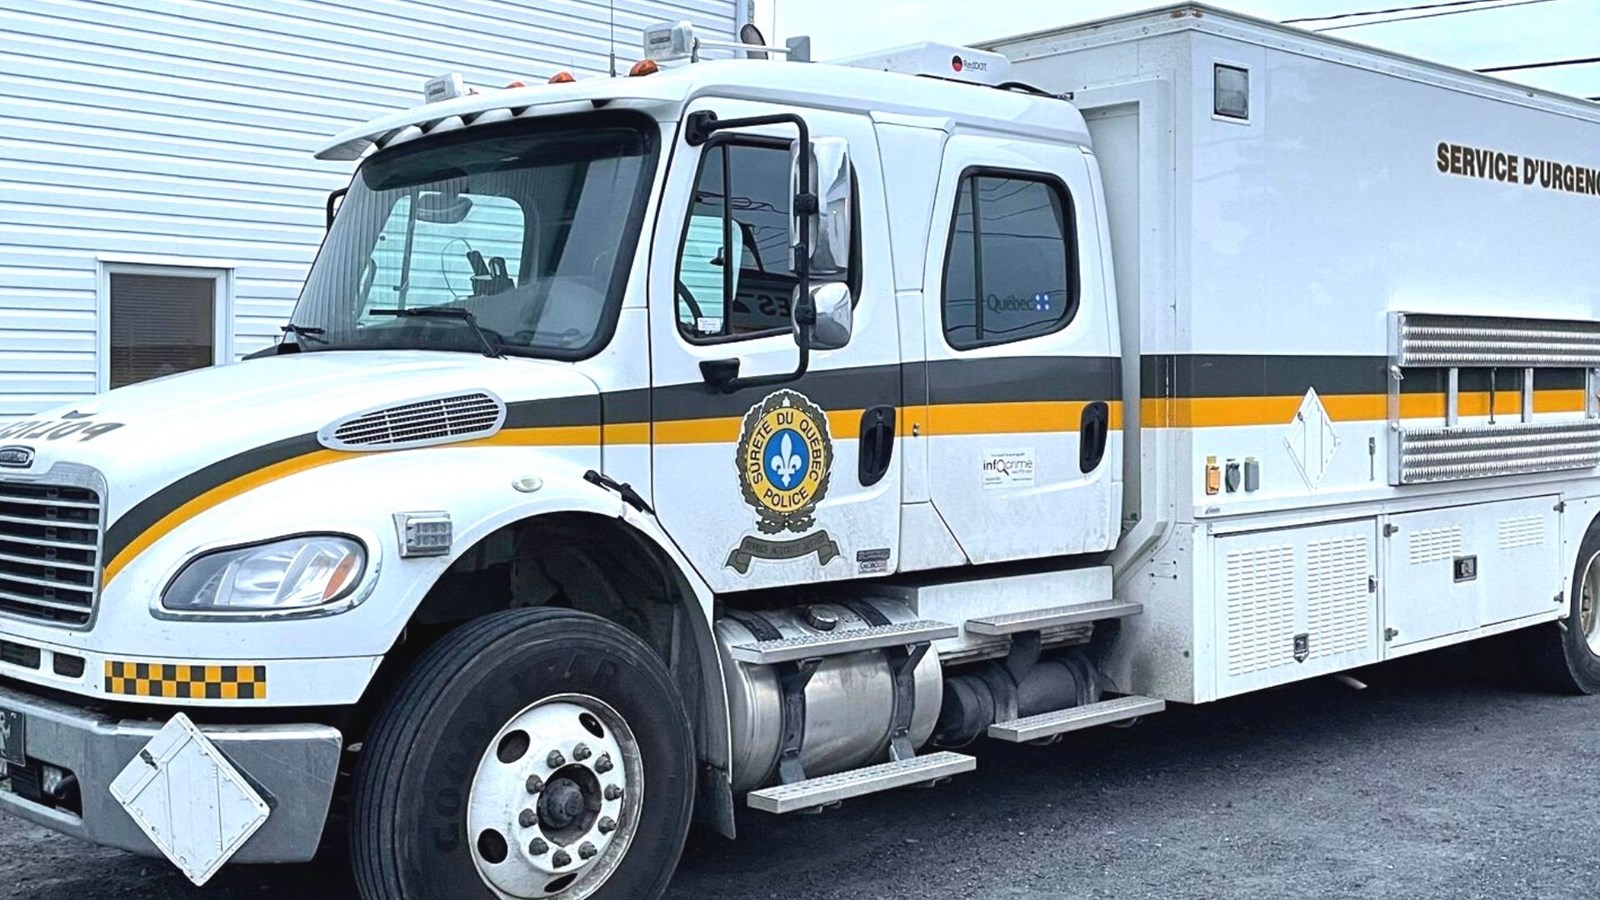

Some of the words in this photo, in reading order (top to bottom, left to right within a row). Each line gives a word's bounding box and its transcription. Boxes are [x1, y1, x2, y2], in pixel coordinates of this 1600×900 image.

[1436, 142, 1518, 184] SERVICE
[776, 412, 794, 426] DU
[763, 486, 809, 507] POLICE
